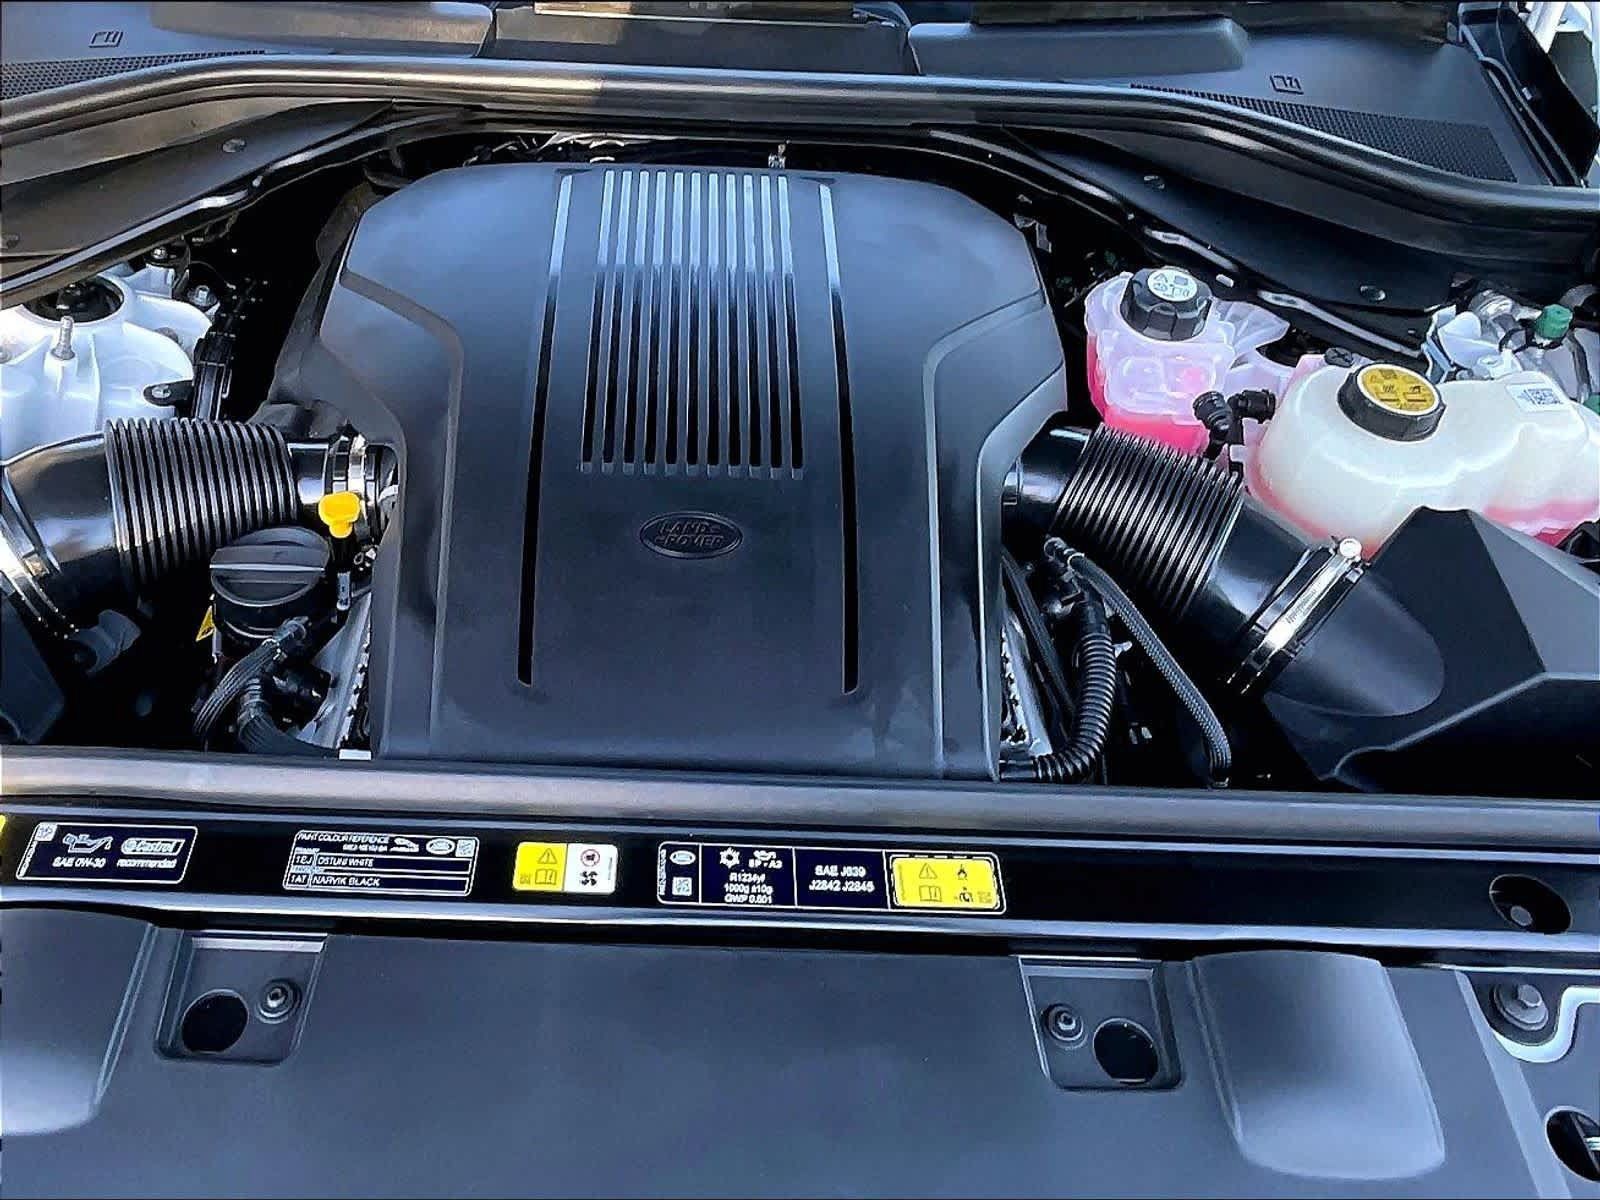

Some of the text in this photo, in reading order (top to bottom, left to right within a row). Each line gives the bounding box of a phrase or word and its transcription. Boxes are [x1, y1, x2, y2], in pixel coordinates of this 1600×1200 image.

[318, 834, 348, 842] COLOUR
[137, 840, 177, 852] Castrol
[52, 856, 74, 867] SAE
[117, 857, 177, 869] recommended
[349, 858, 374, 867] WHITE
[815, 865, 839, 877] SAE
[312, 875, 380, 887] NARVIK BLACK
[808, 879, 841, 891] J2842
[724, 882, 750, 894] 1000g
[724, 893, 748, 903] GWP
